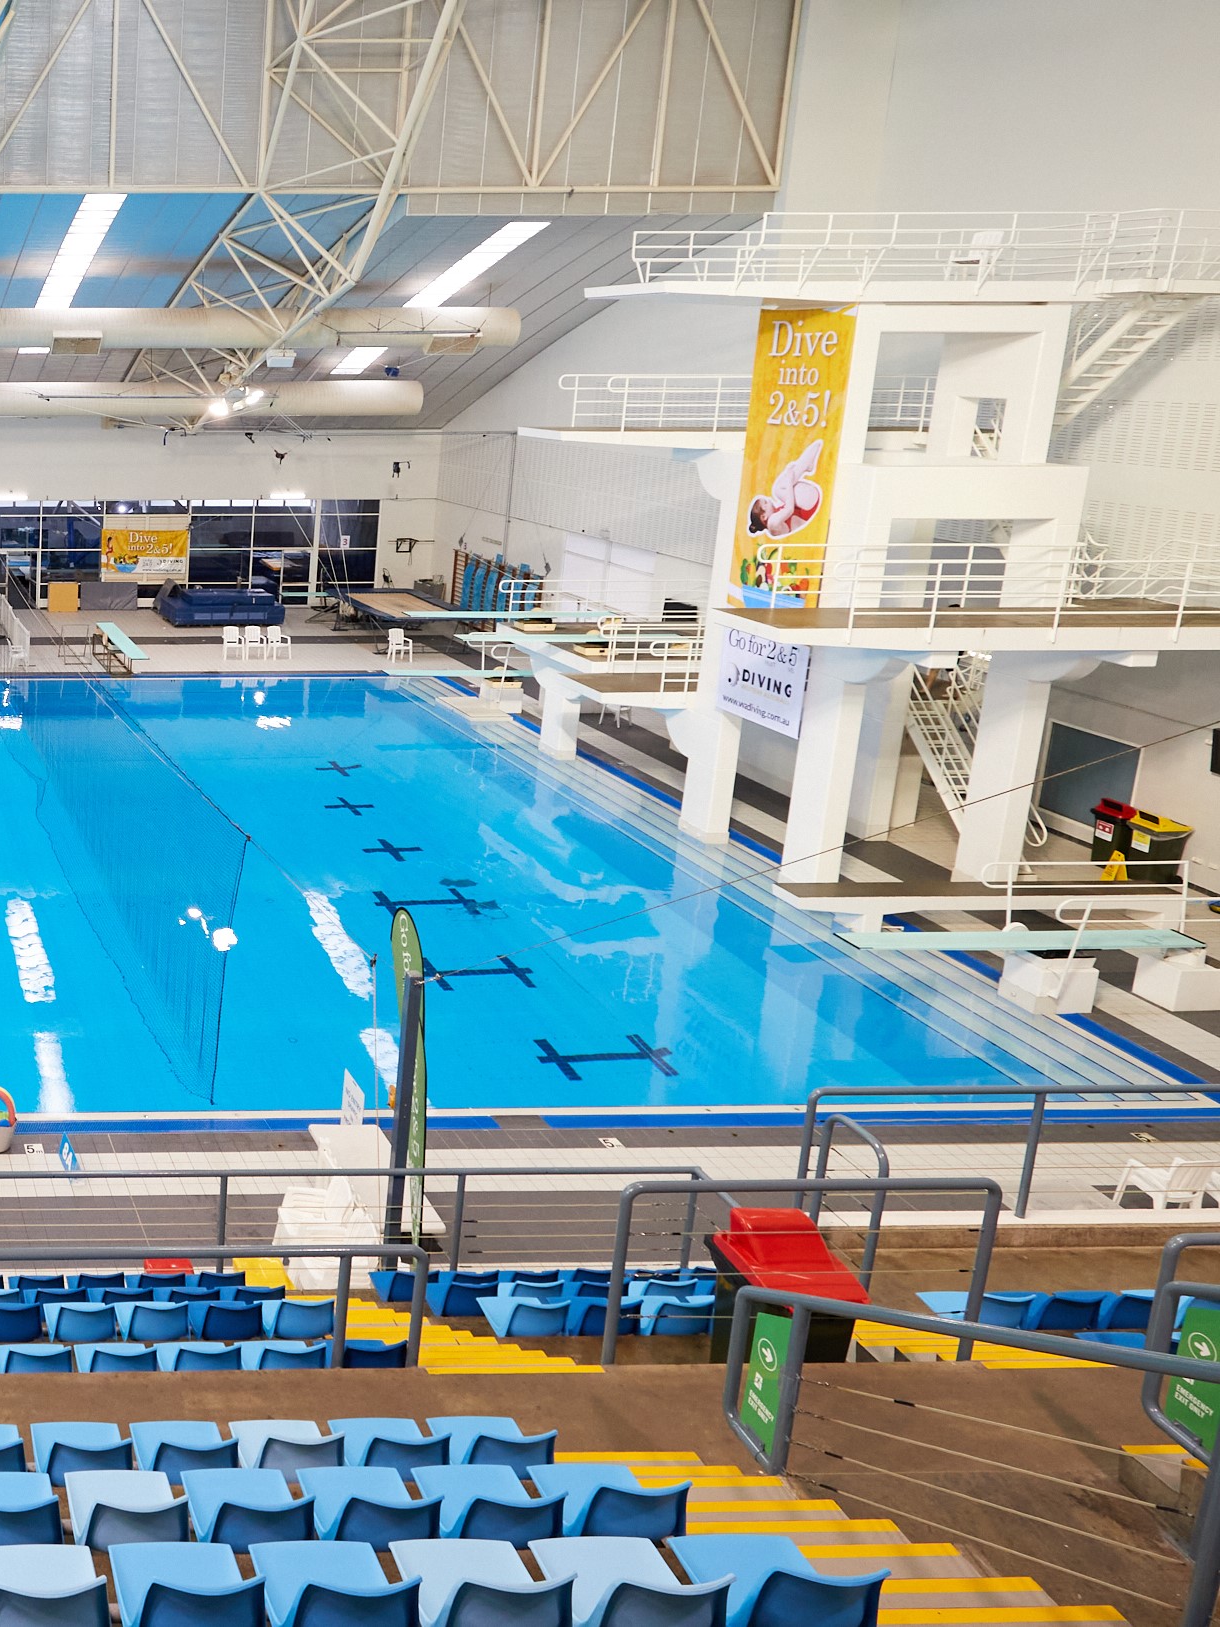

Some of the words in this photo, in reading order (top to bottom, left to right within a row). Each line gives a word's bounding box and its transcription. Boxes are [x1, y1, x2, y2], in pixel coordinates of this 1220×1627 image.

[768, 320, 838, 357] Dive
[778, 359, 819, 386] into
[766, 390, 831, 428] 2&5!
[127, 543, 145, 551] into
[129, 531, 158, 543] Dive
[343, 538, 348, 546] 3
[729, 628, 746, 650] Go
[748, 634, 767, 656] for
[742, 669, 792, 698] DIVING
[722, 694, 790, 727] www.wadiving.com.au
[400, 914, 409, 947] Go
[749, 1389, 774, 1422] EMERGENCY
[1174, 1391, 1188, 1406] EXIT
[1188, 1402, 1205, 1418] ONLY
[1175, 1383, 1214, 1417] EMERGENCY
